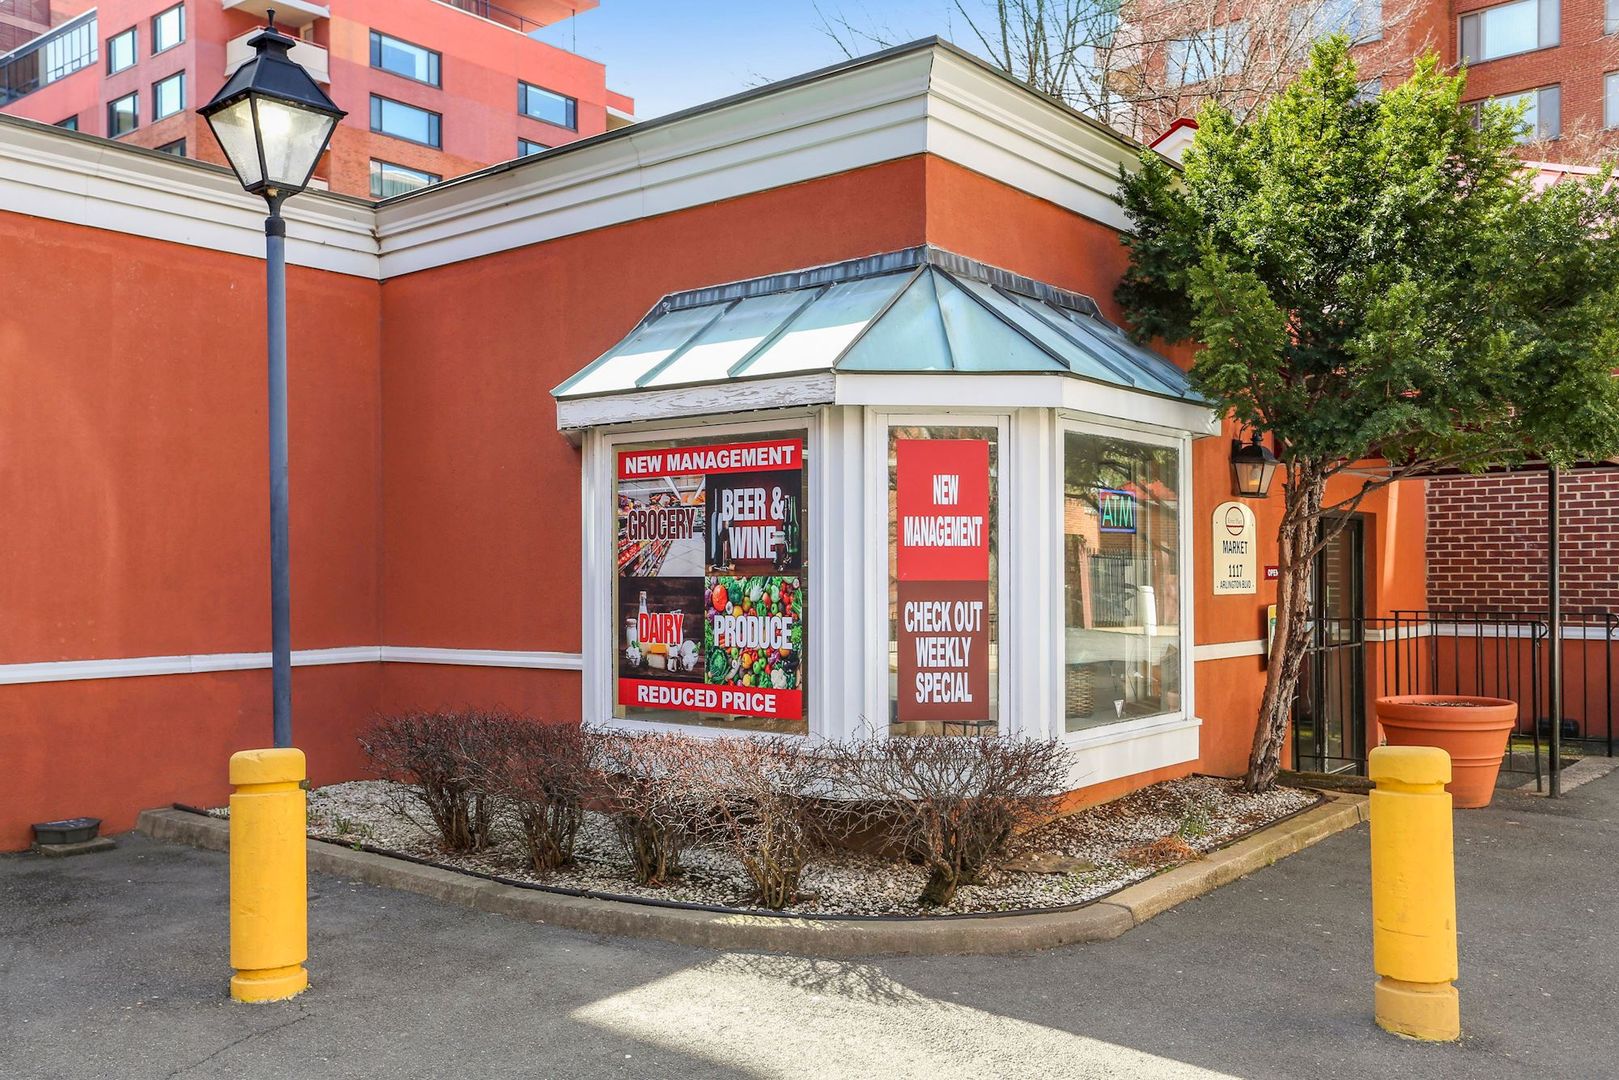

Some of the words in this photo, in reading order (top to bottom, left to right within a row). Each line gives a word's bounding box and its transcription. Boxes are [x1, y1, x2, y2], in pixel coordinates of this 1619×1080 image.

[625, 455, 662, 474] NEW
[666, 446, 795, 471] MANAGEMENT
[722, 488, 766, 521] BEER
[770, 486, 785, 520] &
[933, 474, 959, 505] NEW
[627, 507, 696, 541] GROCERY
[1102, 495, 1133, 527] ATM
[729, 526, 777, 559] WINE
[904, 516, 983, 547] MANAGEMENT
[1222, 540, 1248, 554] MARKET
[1220, 580, 1241, 589] ARLINGTON
[1228, 564, 1243, 577] 1117
[639, 613, 683, 645] DAIRY
[714, 615, 793, 649] PRODUCE
[904, 601, 951, 632] CHECK
[954, 601, 983, 632] OUT
[915, 637, 972, 668] WEEKLY
[637, 685, 717, 708] REDUCED
[722, 693, 776, 713] PRICE
[916, 672, 972, 703] SPECIAL
